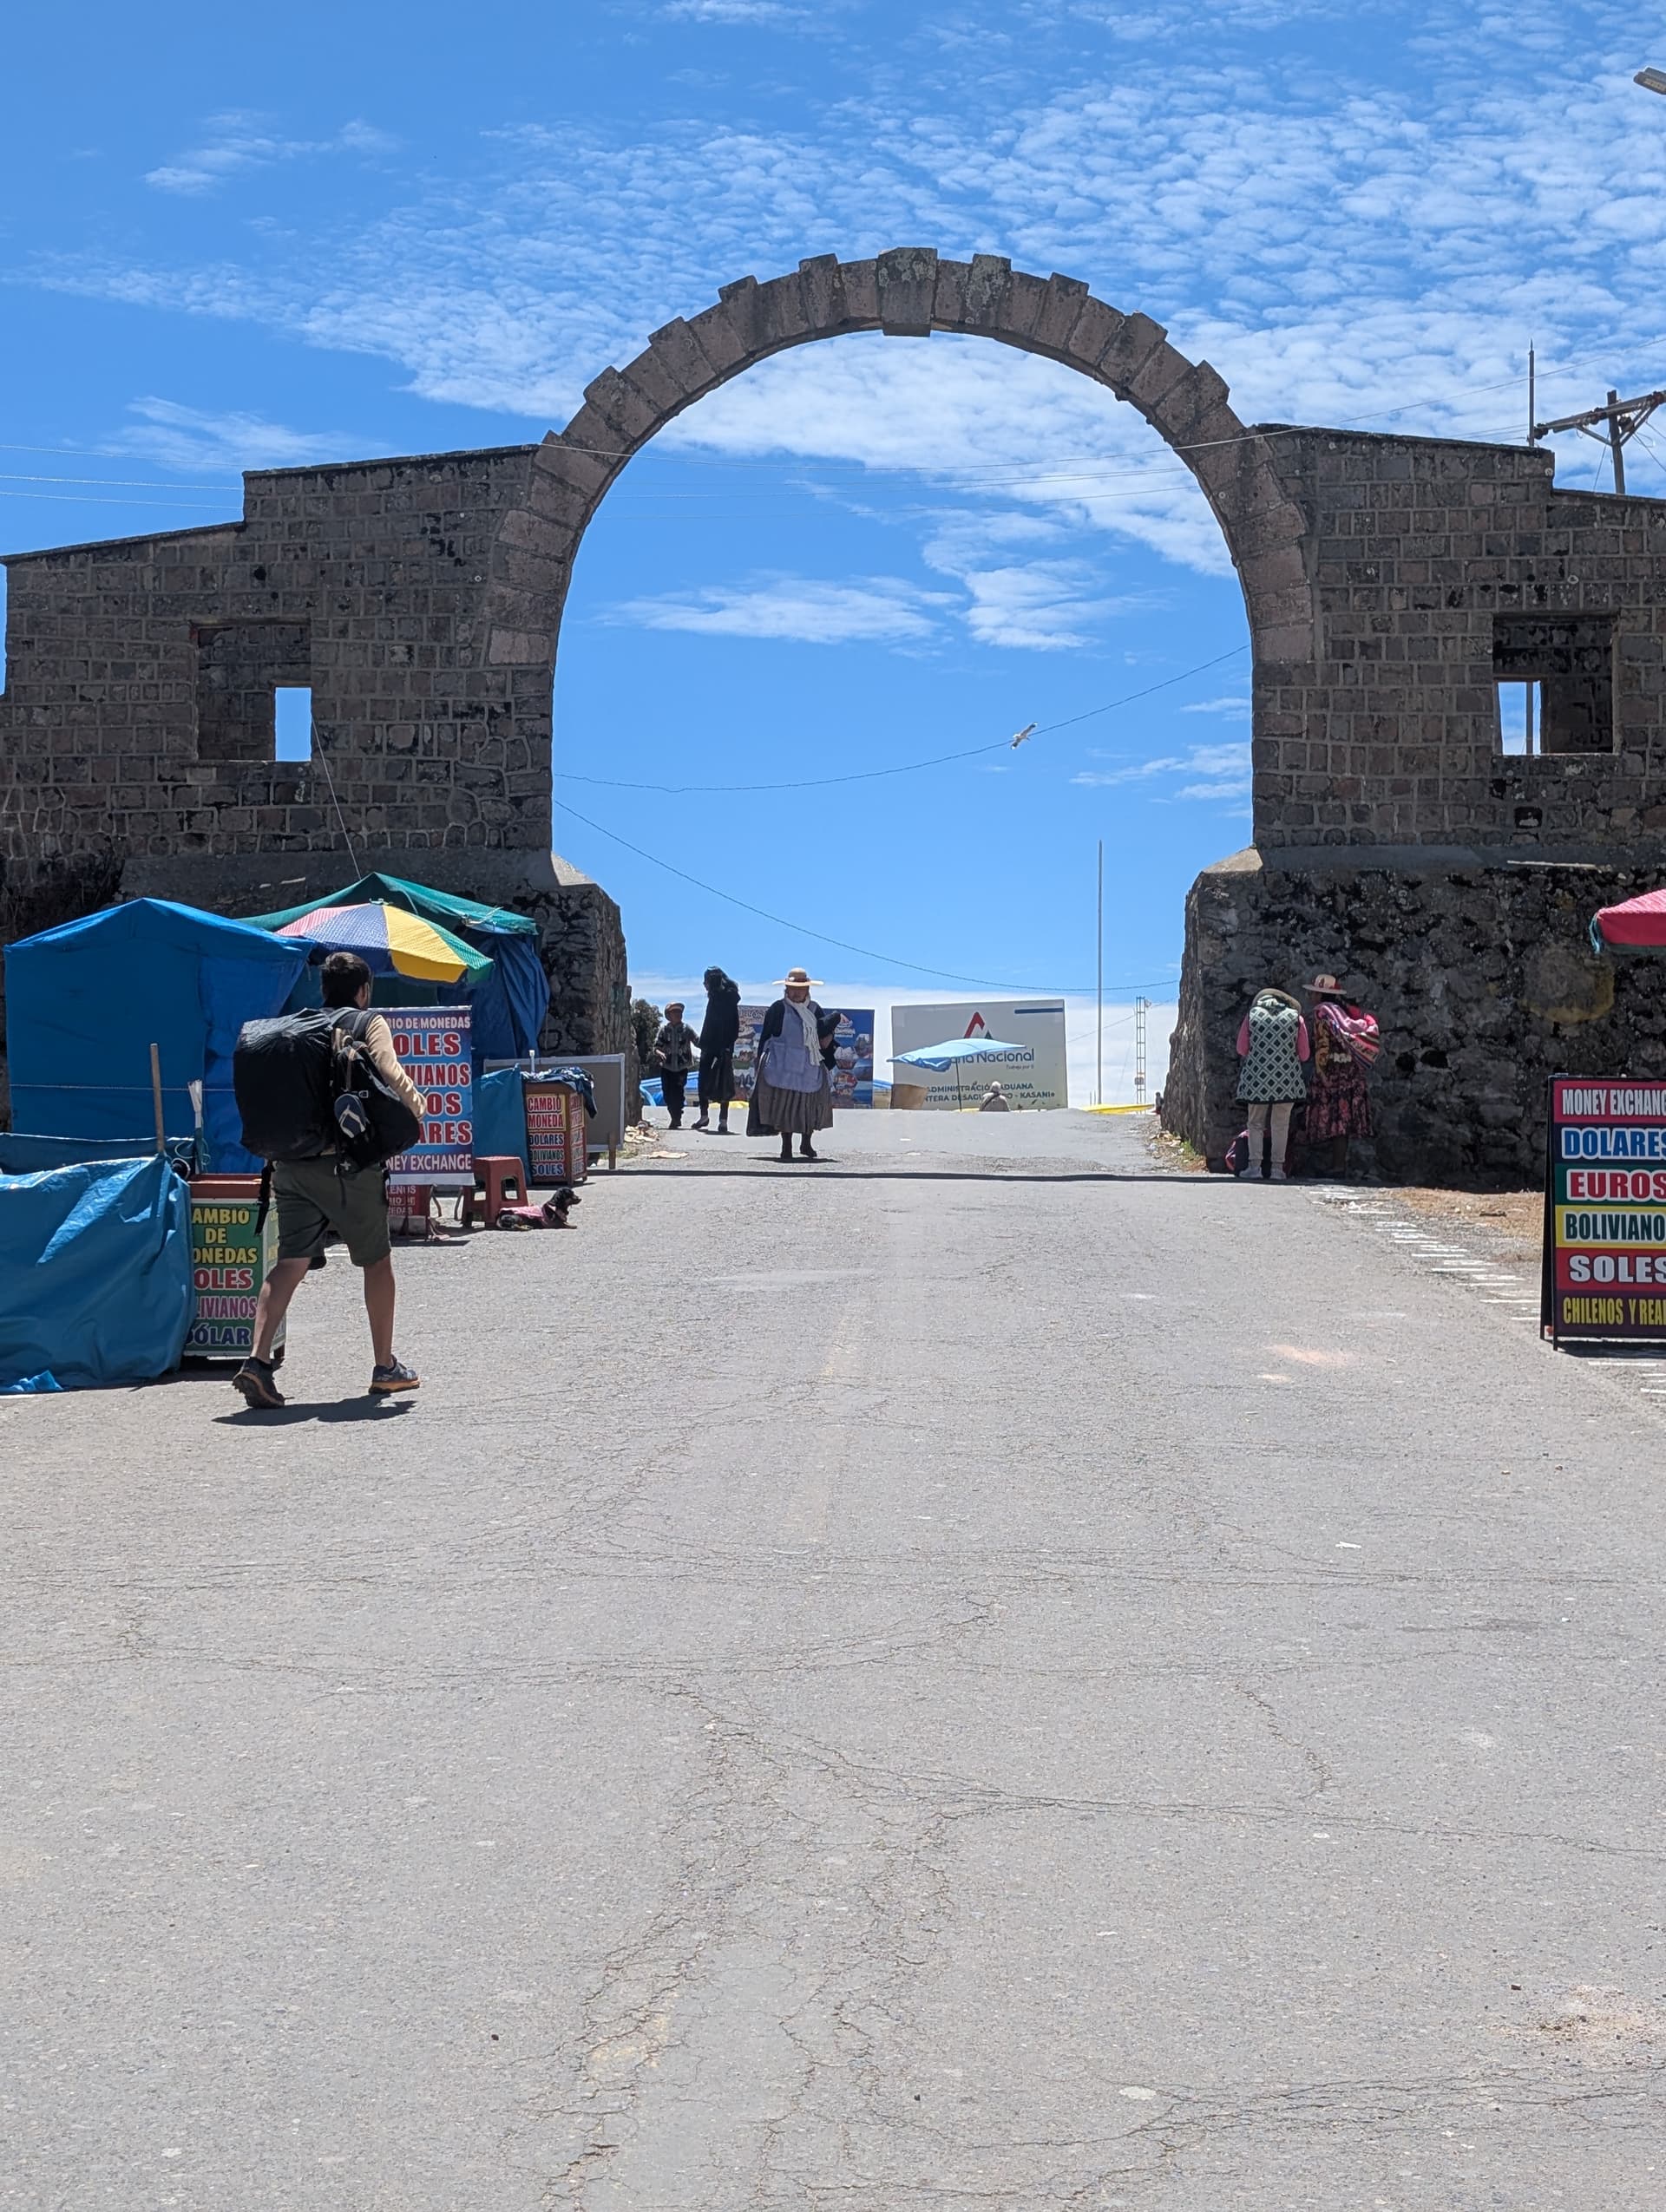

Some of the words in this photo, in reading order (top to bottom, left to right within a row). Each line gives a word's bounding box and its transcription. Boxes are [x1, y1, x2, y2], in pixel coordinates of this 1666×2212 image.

[405, 1018, 418, 1029] DE
[420, 1017, 471, 1029] MONEDAS
[393, 1032, 461, 1057] OLES
[977, 1048, 1034, 1063] Nacional
[403, 1063, 472, 1086] VIANOS
[1563, 1089, 1606, 1116] MONEY
[1610, 1089, 1666, 1116] EXCHANG
[528, 1114, 563, 1128] MONEDA
[419, 1121, 473, 1145] ARES
[387, 1155, 408, 1171] NEY
[410, 1154, 472, 1171] EXCHANGE
[1568, 1171, 1666, 1200] EUROS
[192, 1207, 250, 1224] AMBIO
[205, 1227, 227, 1244] DE
[1565, 1213, 1666, 1241] BOLIVIANO
[193, 1247, 258, 1264] ONEDAS
[194, 1269, 253, 1290] OLES
[1564, 1298, 1624, 1325] CHILENOS
[1629, 1299, 1637, 1325] Y
